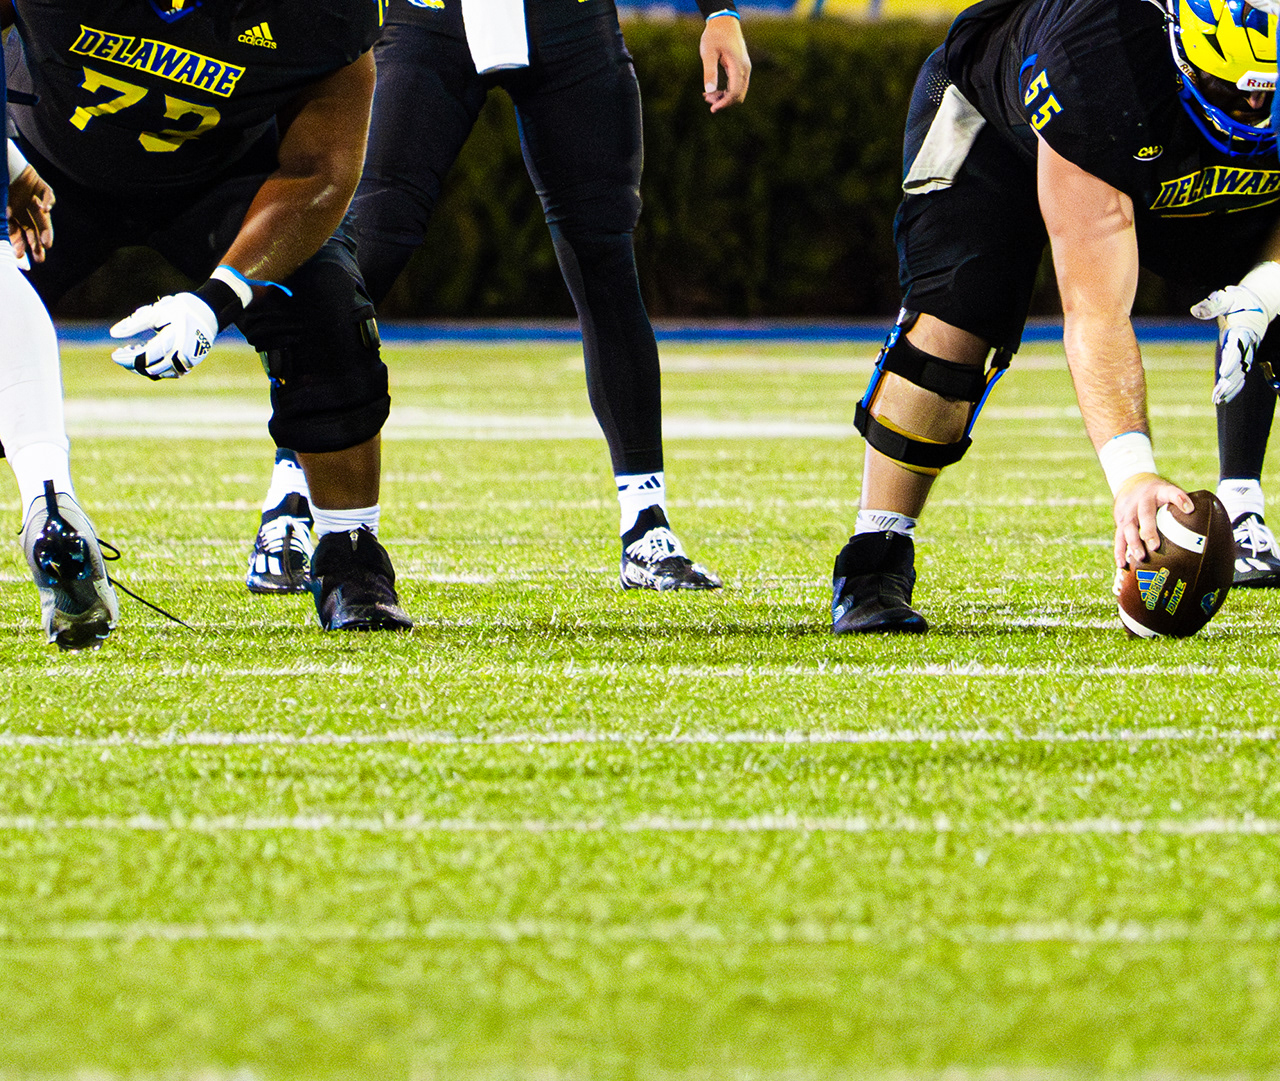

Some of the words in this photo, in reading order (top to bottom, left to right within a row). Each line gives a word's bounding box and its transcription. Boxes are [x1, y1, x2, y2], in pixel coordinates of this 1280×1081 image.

[68, 24, 247, 98] DELAWARE
[237, 34, 278, 50] adidas
[69, 66, 222, 153] 73
[1024, 70, 1062, 131] 55
[1145, 566, 1170, 612] adidas
[1166, 579, 1188, 616] DIME
